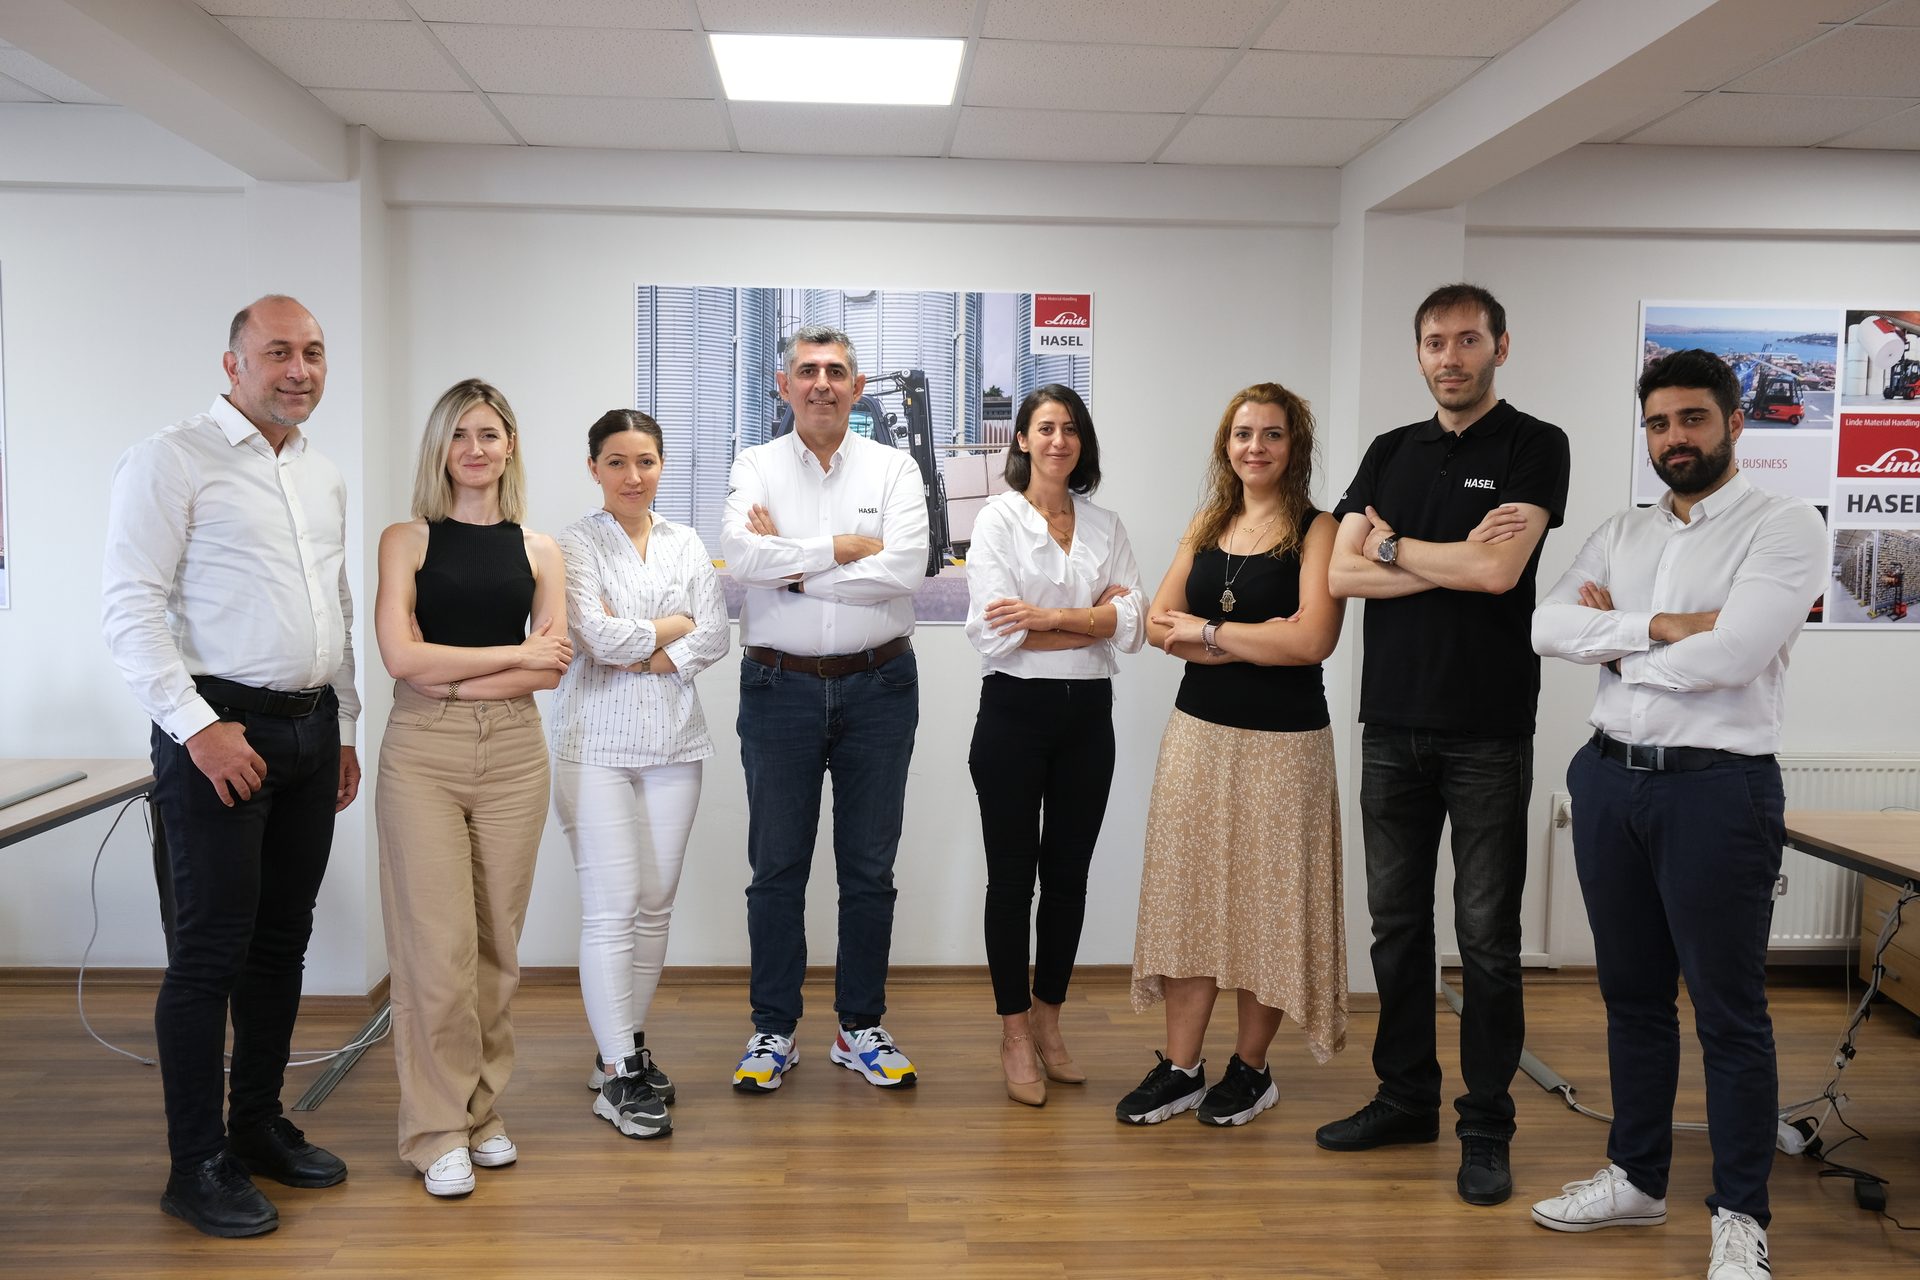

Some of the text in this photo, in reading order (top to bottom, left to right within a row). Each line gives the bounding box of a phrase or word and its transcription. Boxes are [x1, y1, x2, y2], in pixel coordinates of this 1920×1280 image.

[1044, 311, 1087, 326] Linde
[1040, 335, 1083, 346] HASEL
[1845, 418, 1920, 428] Linde Material Handling
[1742, 457, 1788, 469] BUSINESS
[1464, 478, 1497, 490] HASEL
